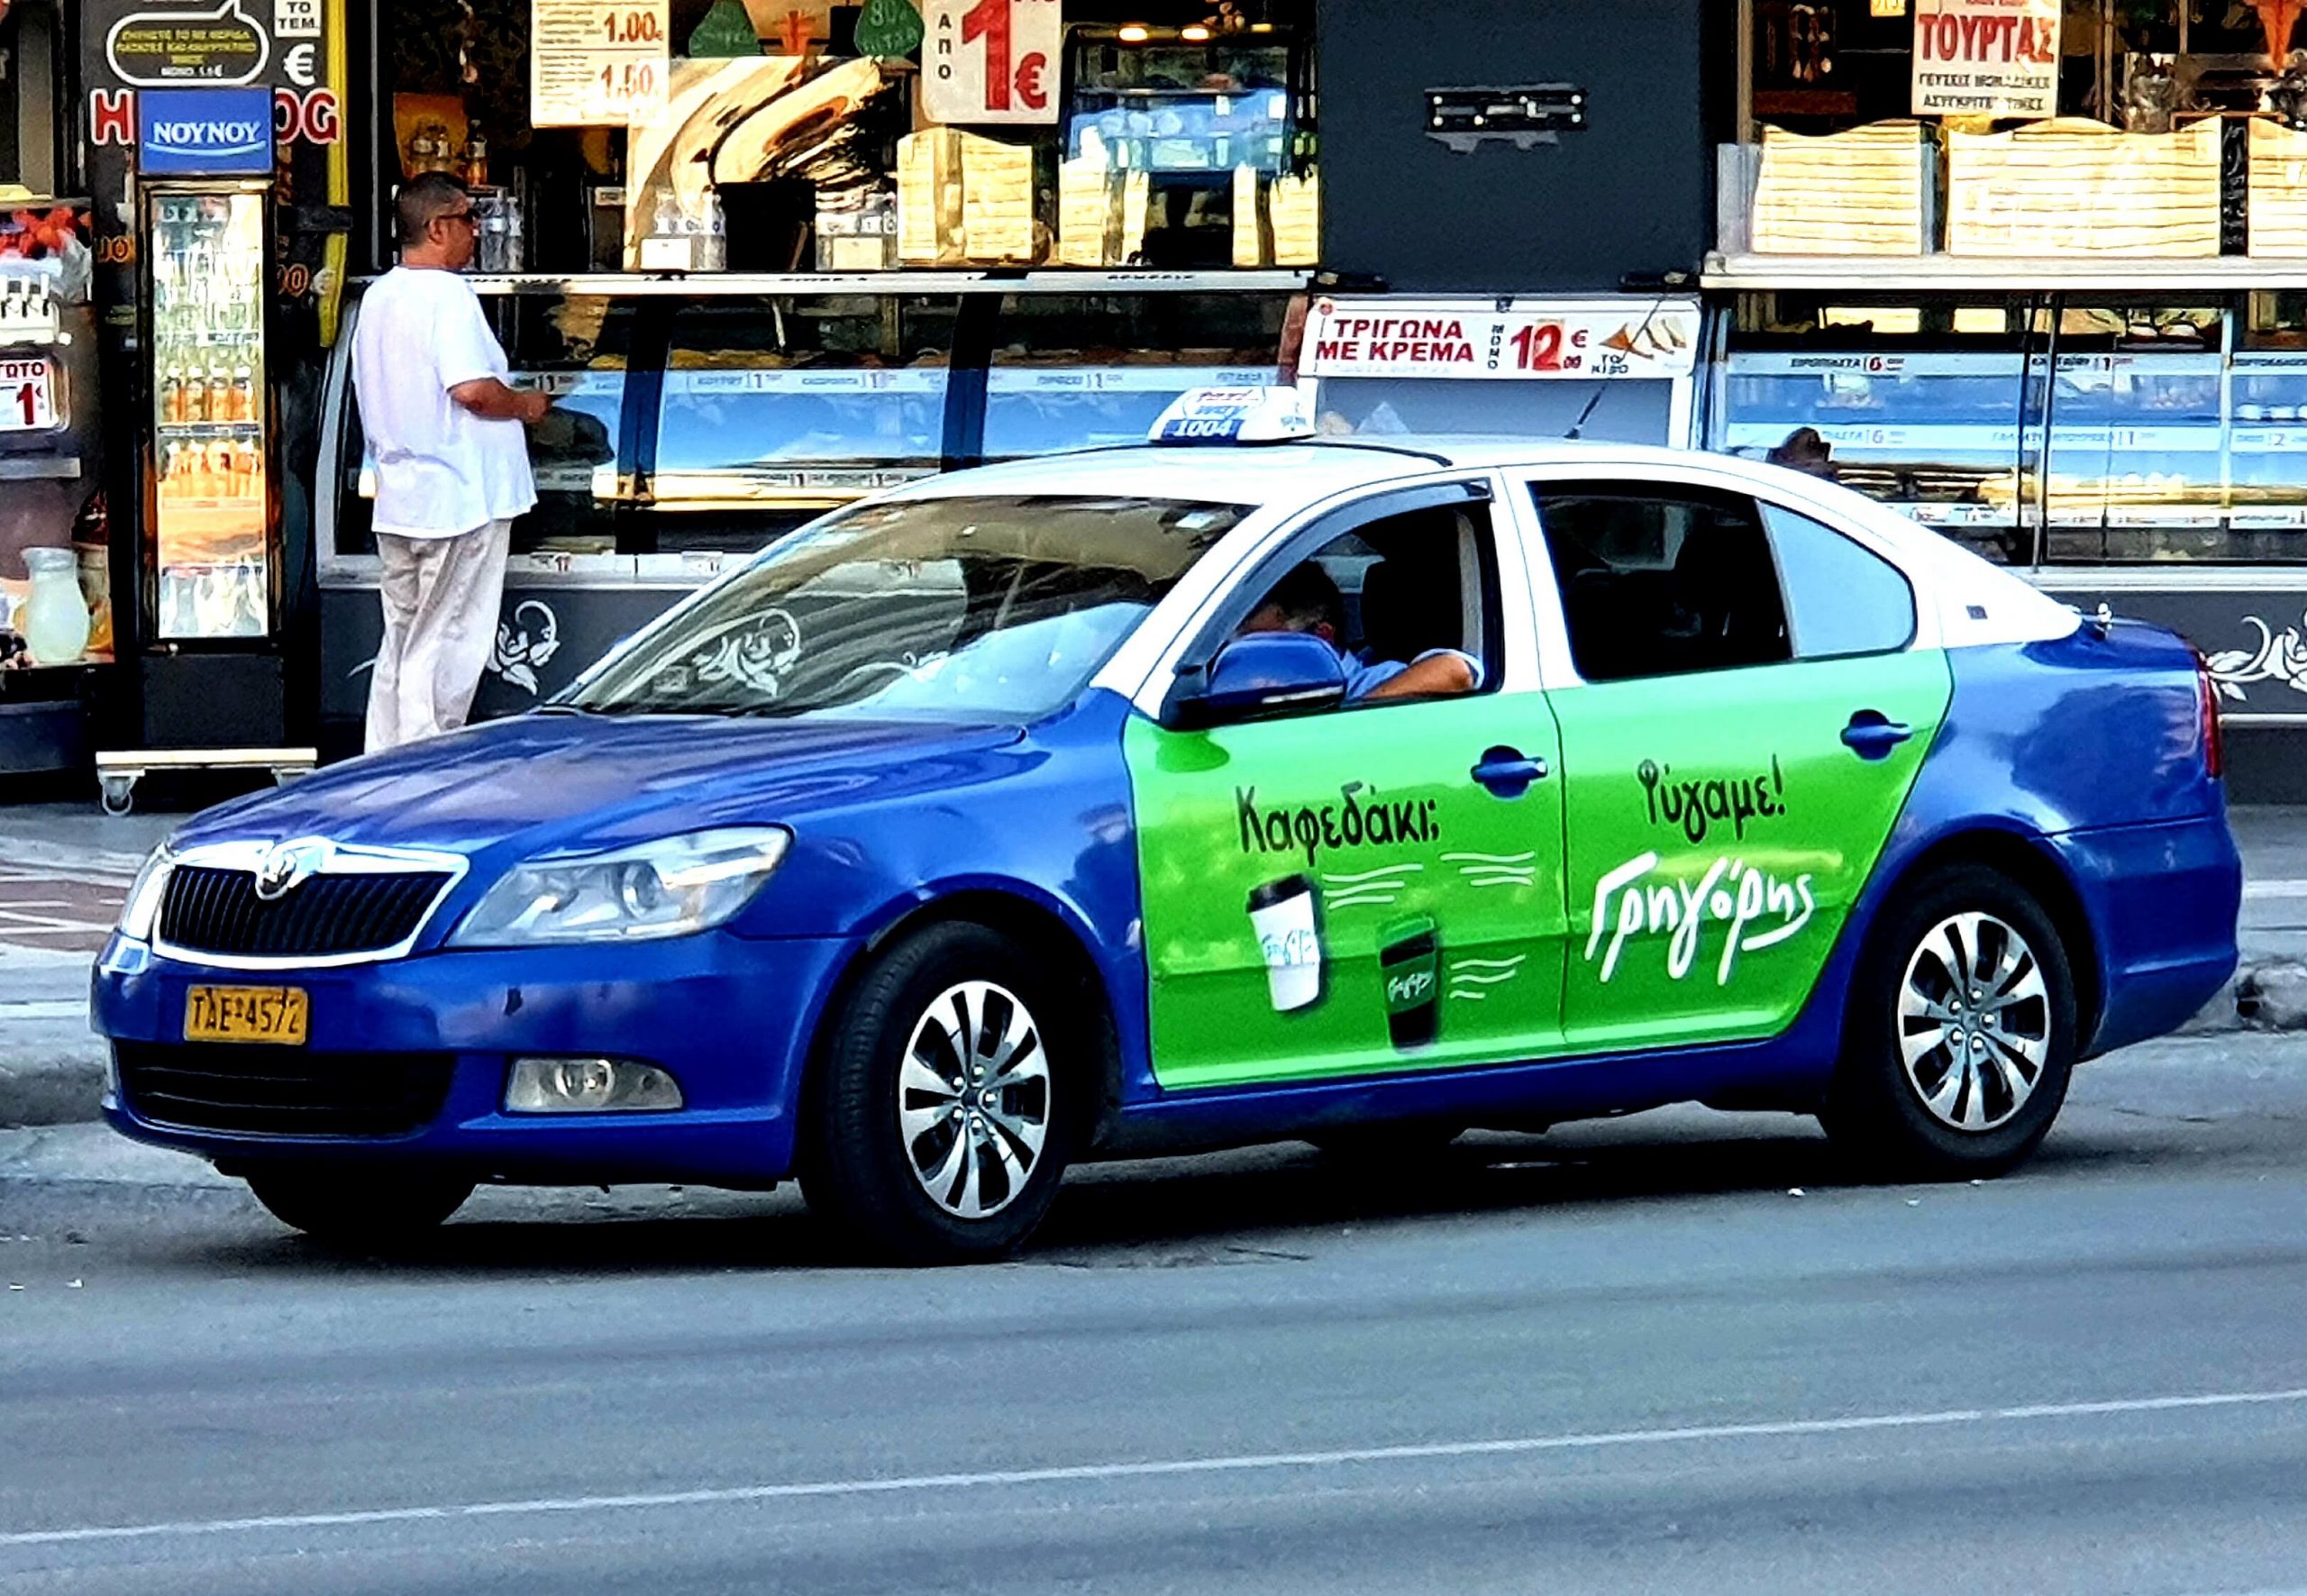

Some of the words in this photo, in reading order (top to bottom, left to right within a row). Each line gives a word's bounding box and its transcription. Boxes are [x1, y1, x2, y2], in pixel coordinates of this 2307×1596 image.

[604, 11, 656, 42] 1.00
[1334, 318, 1463, 339] ΤΡΙΓΩΝΑ
[1316, 341, 1360, 360] ΜΕ
[1369, 341, 1474, 362] ΚΡΕΜΑ
[1510, 324, 1562, 370] 12
[1571, 330, 1589, 349] €
[0, 362, 44, 378] ΩΤΟ
[1173, 421, 1233, 437] 1004
[1235, 780, 1440, 867] Καφεδάκι;
[1583, 851, 1815, 987] Γρηγόρης
